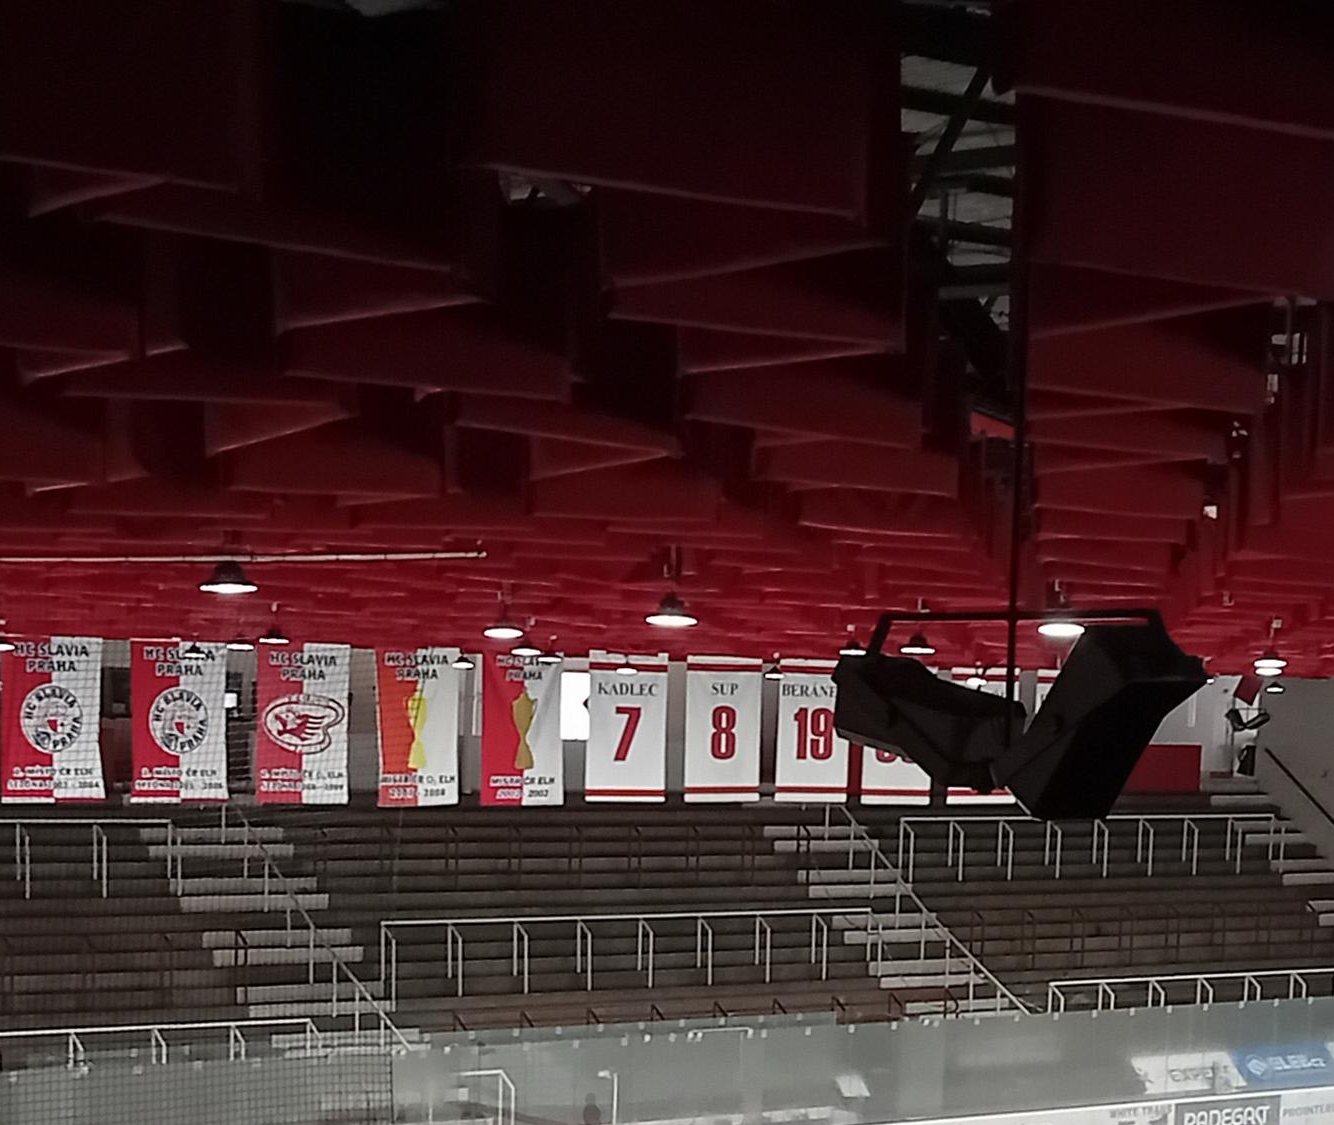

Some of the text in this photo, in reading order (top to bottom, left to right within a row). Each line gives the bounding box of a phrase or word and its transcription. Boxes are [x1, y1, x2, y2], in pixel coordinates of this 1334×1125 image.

[38, 643, 89, 657] SLAVIA
[145, 647, 215, 661] HC SLA
[270, 652, 338, 667] HC SLAVIA
[387, 652, 450, 665] HC SLAVIA
[27, 659, 77, 673] PRAHA
[157, 663, 203, 676] PRAHA
[282, 669, 327, 681] PRAHA
[508, 671, 543, 681] PRAHA
[597, 682, 660, 698] KADLEC
[710, 682, 740, 697] SUP
[612, 706, 642, 762] 7
[710, 704, 737, 761] 8
[793, 706, 835, 761] 19
